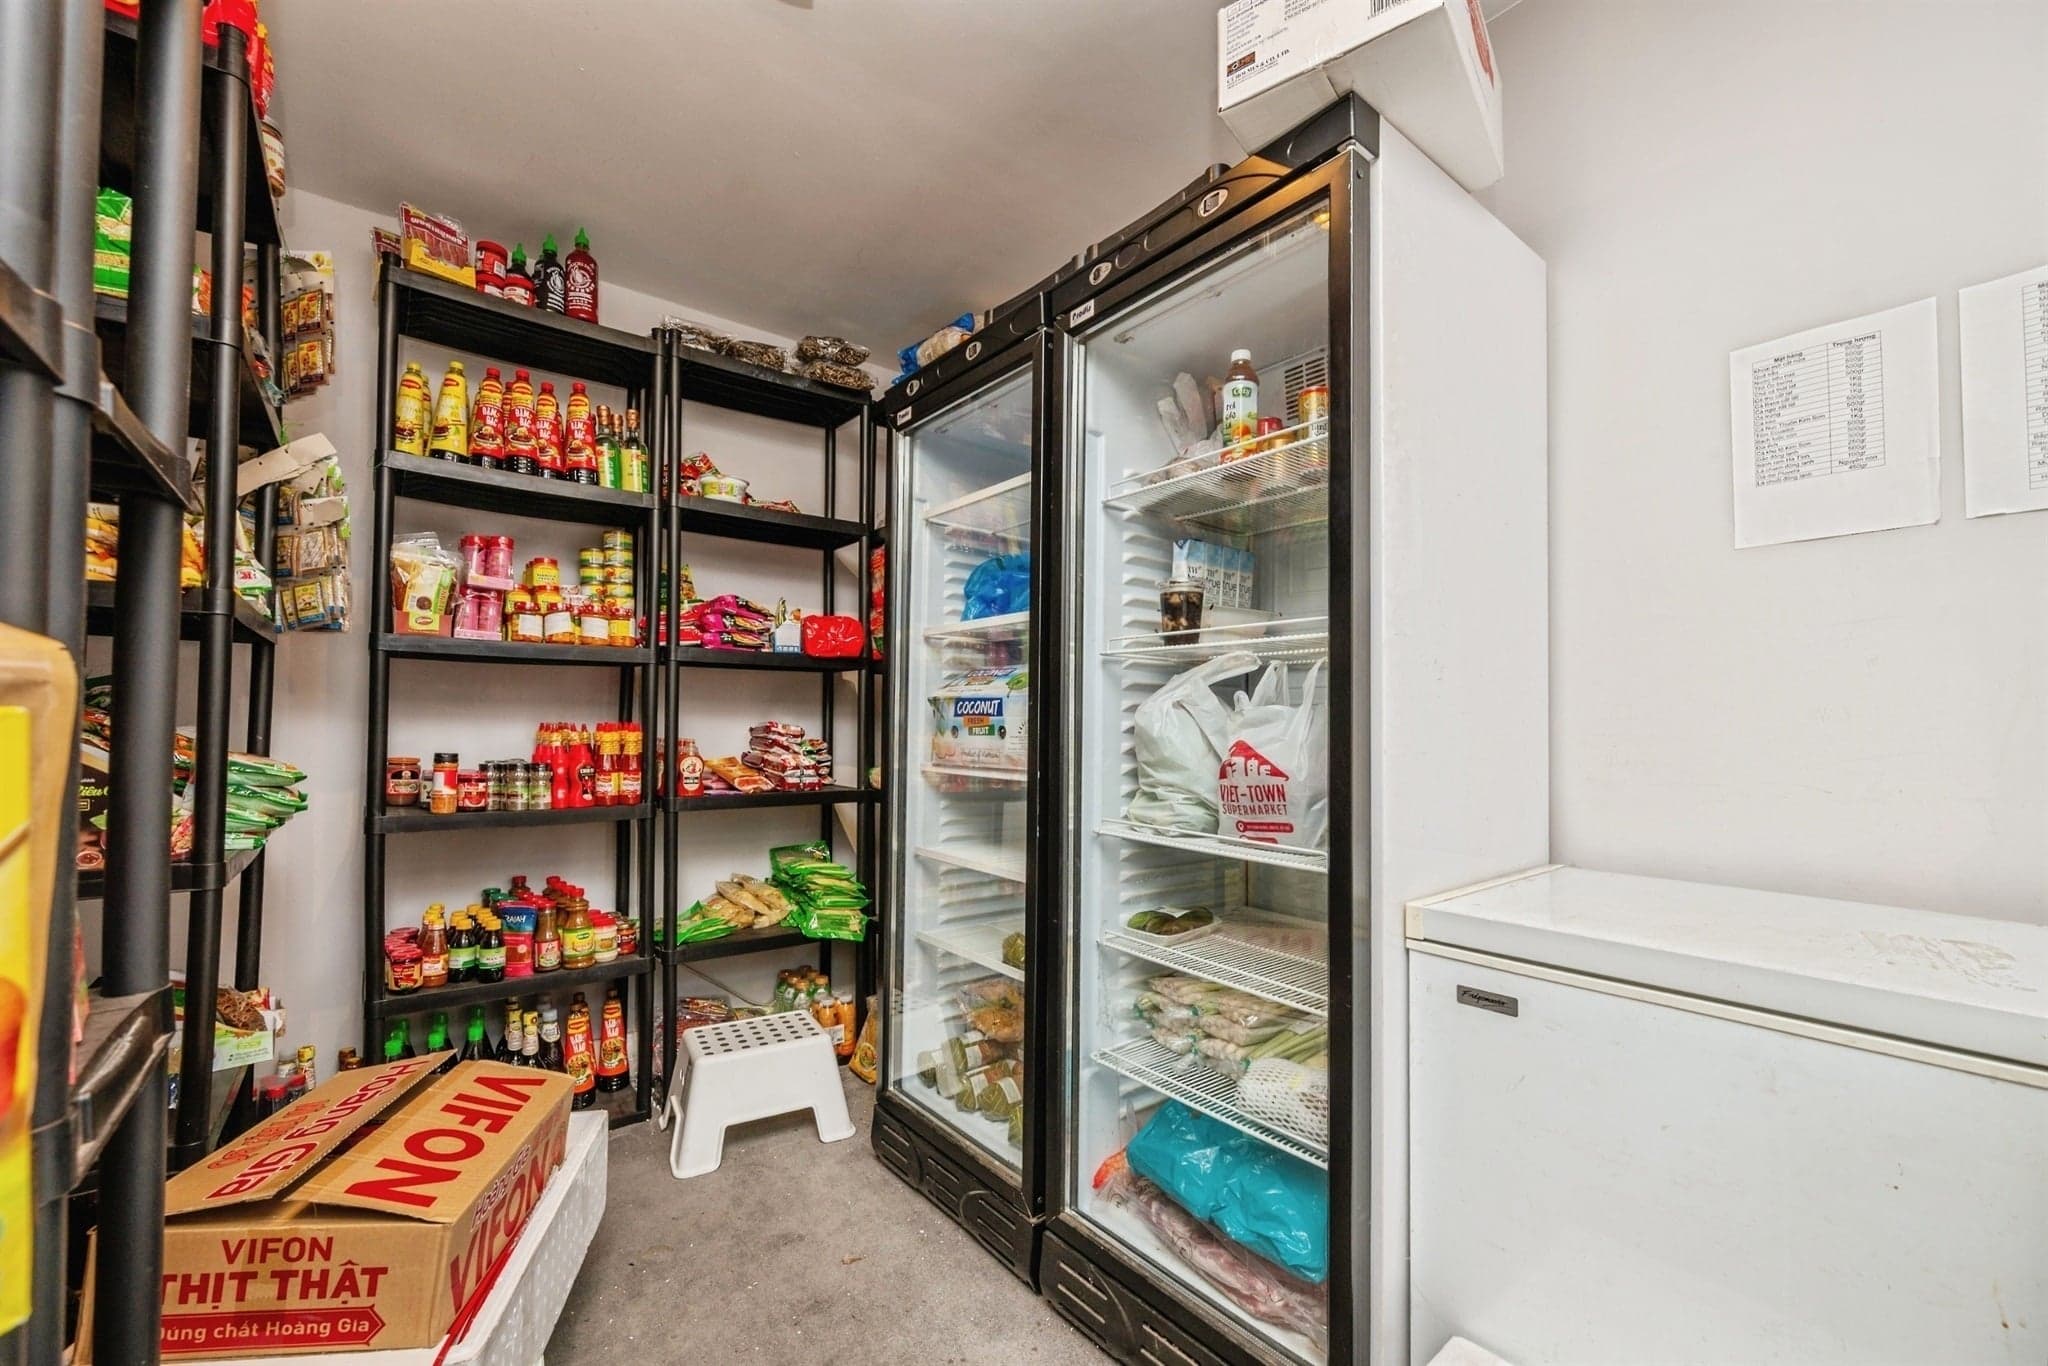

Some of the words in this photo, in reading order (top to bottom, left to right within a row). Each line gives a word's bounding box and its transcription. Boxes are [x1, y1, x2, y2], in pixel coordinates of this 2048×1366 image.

[956, 699, 1001, 715] COCONUT
[1220, 784, 1287, 803] VIET-TOWN
[1222, 804, 1288, 816] SUPERMARKET
[344, 1076, 549, 1208] VIFON
[450, 1138, 551, 1317] VIFON
[221, 1236, 334, 1265] VIFON
[161, 1271, 259, 1310] THỊT
[270, 1259, 389, 1305] THẬT
[213, 1319, 259, 1339] chất
[265, 1320, 331, 1338] Hoàng
[337, 1318, 370, 1334] Gia
